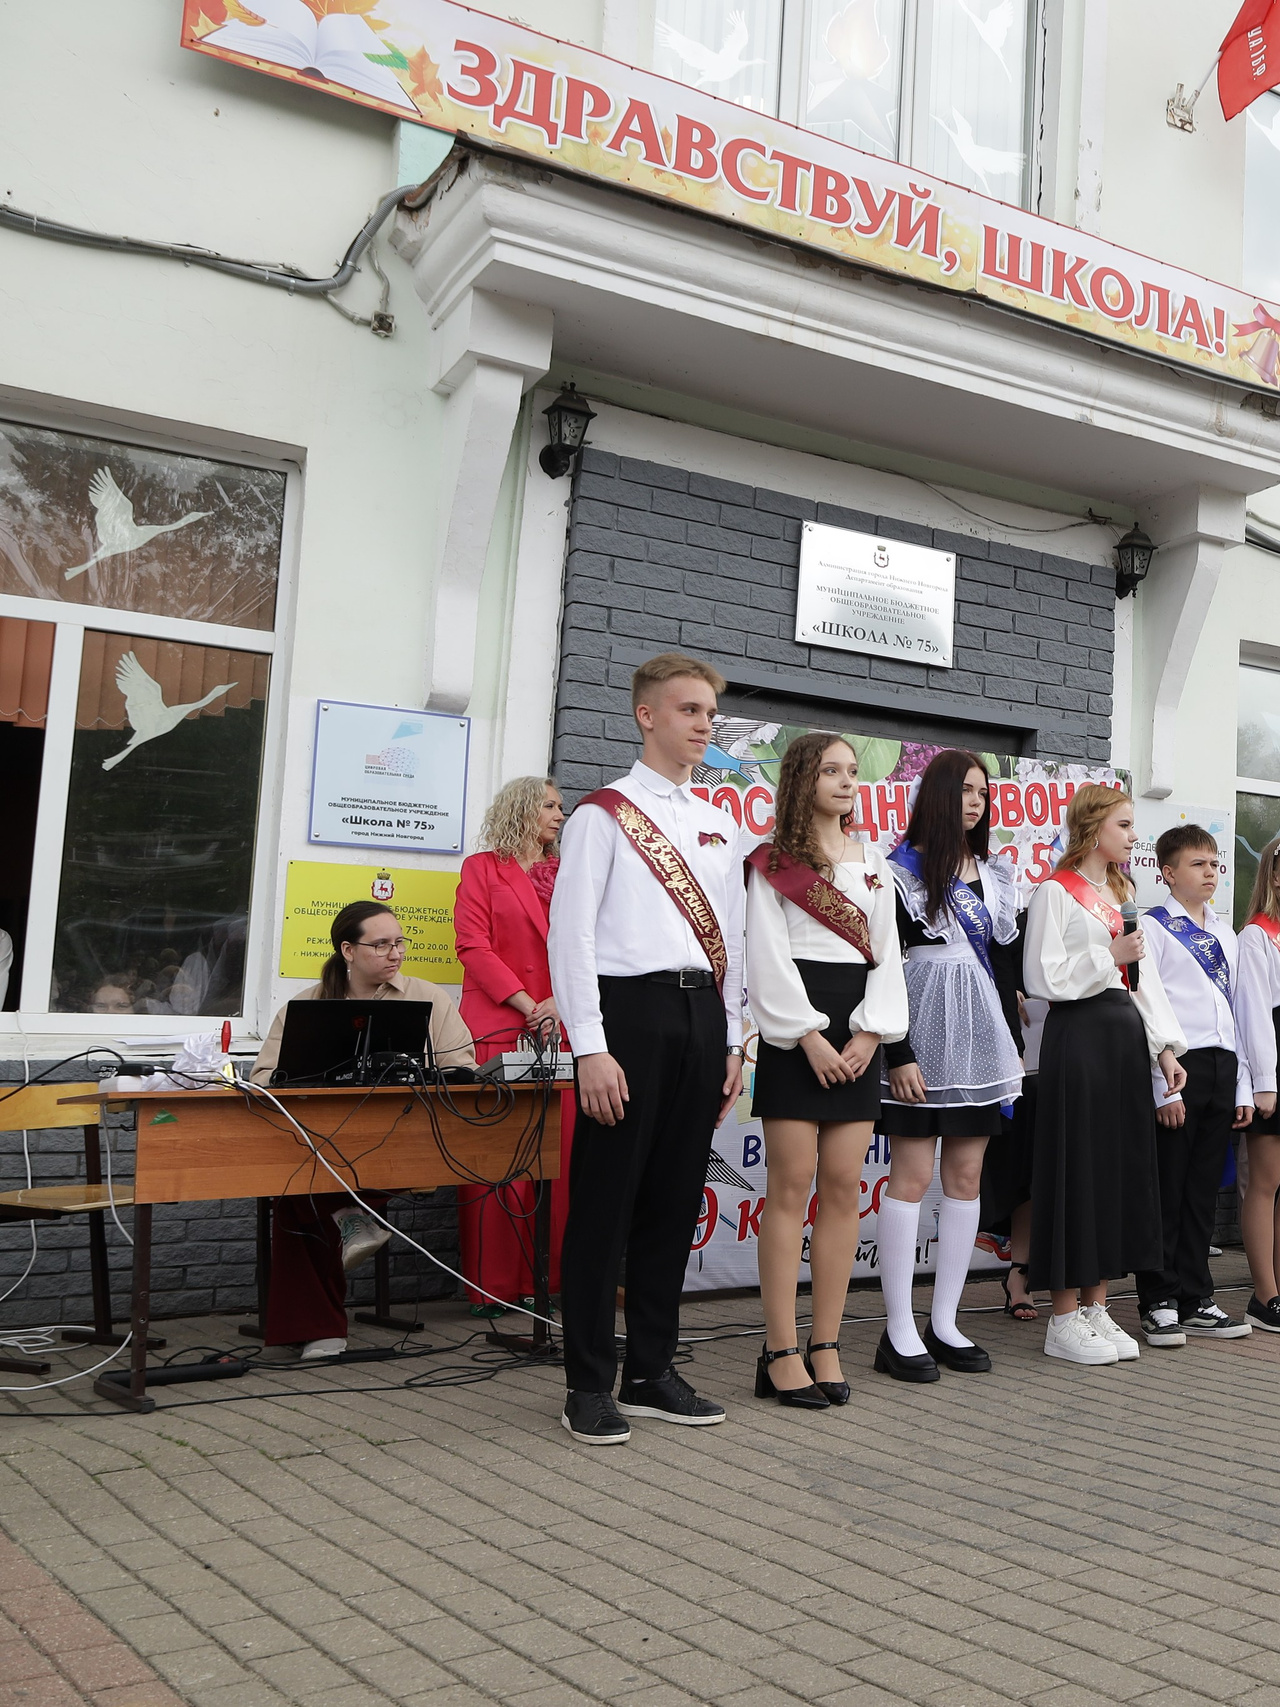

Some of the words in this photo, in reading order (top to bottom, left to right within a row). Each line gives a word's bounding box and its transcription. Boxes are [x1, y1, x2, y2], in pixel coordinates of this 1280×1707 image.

[445, 38, 960, 274] ЗДРАВСТВУЙ,
[980, 224, 1227, 355] ШКОЛА!
[818, 560, 867, 575] Администрация
[867, 570, 888, 580] города
[889, 574, 917, 586] Нижнего
[918, 580, 949, 593] Новгорода
[845, 574, 885, 587] Департамент
[886, 582, 923, 595] образования
[815, 585, 889, 604] МУНИЦИПАЛЬНОЕ
[890, 599, 940, 615] БЮДЖЕТНОЕ
[830, 597, 926, 620] ОБЩЕОБРАЗОВАТЕЛЬНОЕ
[851, 609, 905, 624] УЧРЕЖДЕНИЕ
[812, 621, 888, 645] «ШКОЛА
[893, 634, 913, 649] №
[917, 638, 939, 653] 75»
[327, 802, 407, 814] ОБЩЕОБРАЗОВАТЕЛЬНОЕ
[408, 808, 450, 817] УЧРЕЖДЕНИЕ
[341, 796, 397, 806] МУНИЦИПАЛЬНОЕ
[398, 802, 438, 810] БЮДЖЕТНОЕ
[341, 815, 393, 828] «Школа
[396, 819, 411, 829] №
[413, 820, 435, 831] 75»
[351, 830, 370, 838] город
[370, 831, 395, 839] Нижний
[396, 832, 424, 841] Новгород
[395, 905, 449, 915] БЮДЖЕТНОЕ
[636, 832, 714, 934] Выпускник
[702, 928, 728, 982] 2025
[408, 915, 453, 923] УЧРЕЖДЕН
[405, 926, 424, 935] 75»
[306, 937, 332, 945] РЕЖИ
[412, 942, 425, 950] ДО
[427, 943, 448, 951] 20.00
[403, 956, 444, 964] ВИЖЕНЦЕВ,
